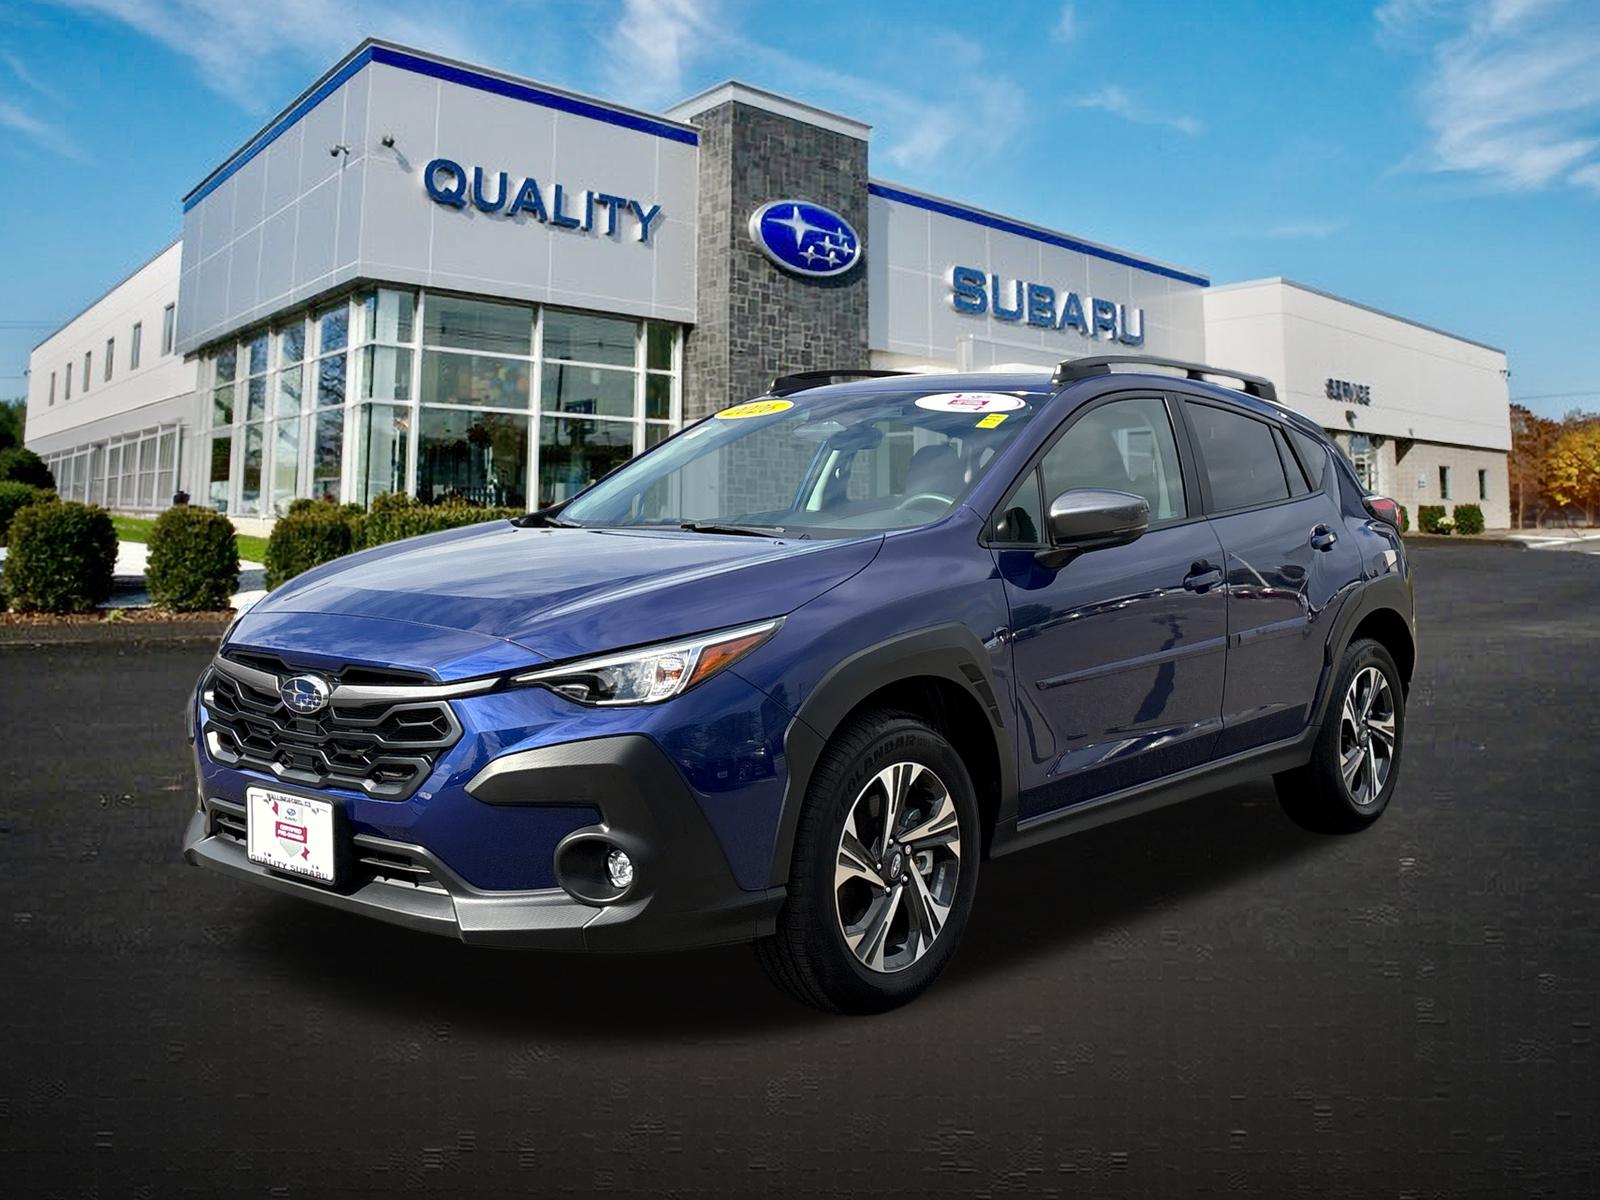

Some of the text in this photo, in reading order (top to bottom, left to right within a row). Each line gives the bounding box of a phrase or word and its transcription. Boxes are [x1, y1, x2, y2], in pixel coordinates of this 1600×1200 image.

[424, 158, 662, 242] QUALITY
[951, 265, 1145, 347] SUBARU
[1325, 378, 1370, 406] SERVICE
[250, 854, 328, 880] QUALITY SUBARU
